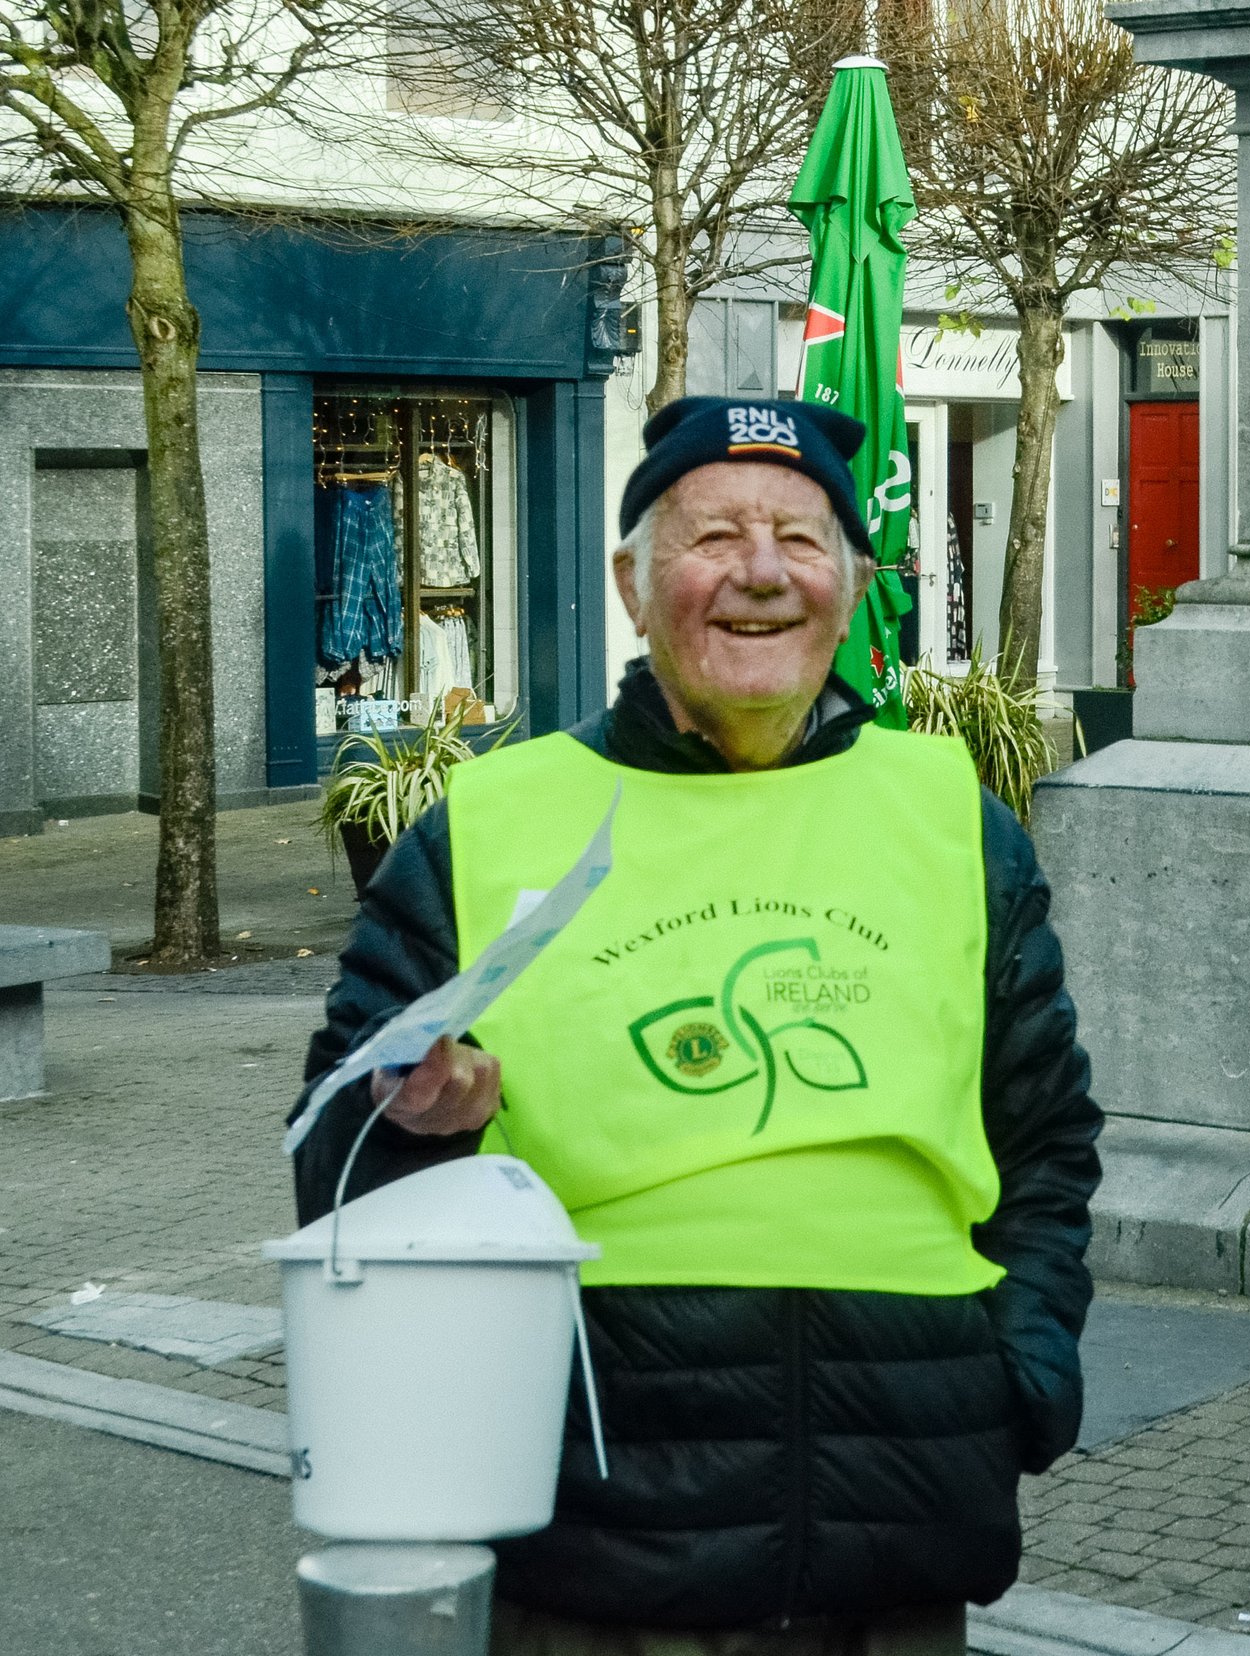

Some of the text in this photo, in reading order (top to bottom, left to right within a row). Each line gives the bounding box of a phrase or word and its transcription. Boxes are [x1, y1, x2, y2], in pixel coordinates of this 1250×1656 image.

[905, 325, 1020, 390] Donnelly
[1157, 362, 1194, 378] House
[727, 406, 796, 430] RNLI
[729, 423, 799, 447] 200
[592, 898, 889, 966] Wexford Lions Club
[807, 964, 848, 980] Clubs
[765, 981, 871, 1004] IRELAND
